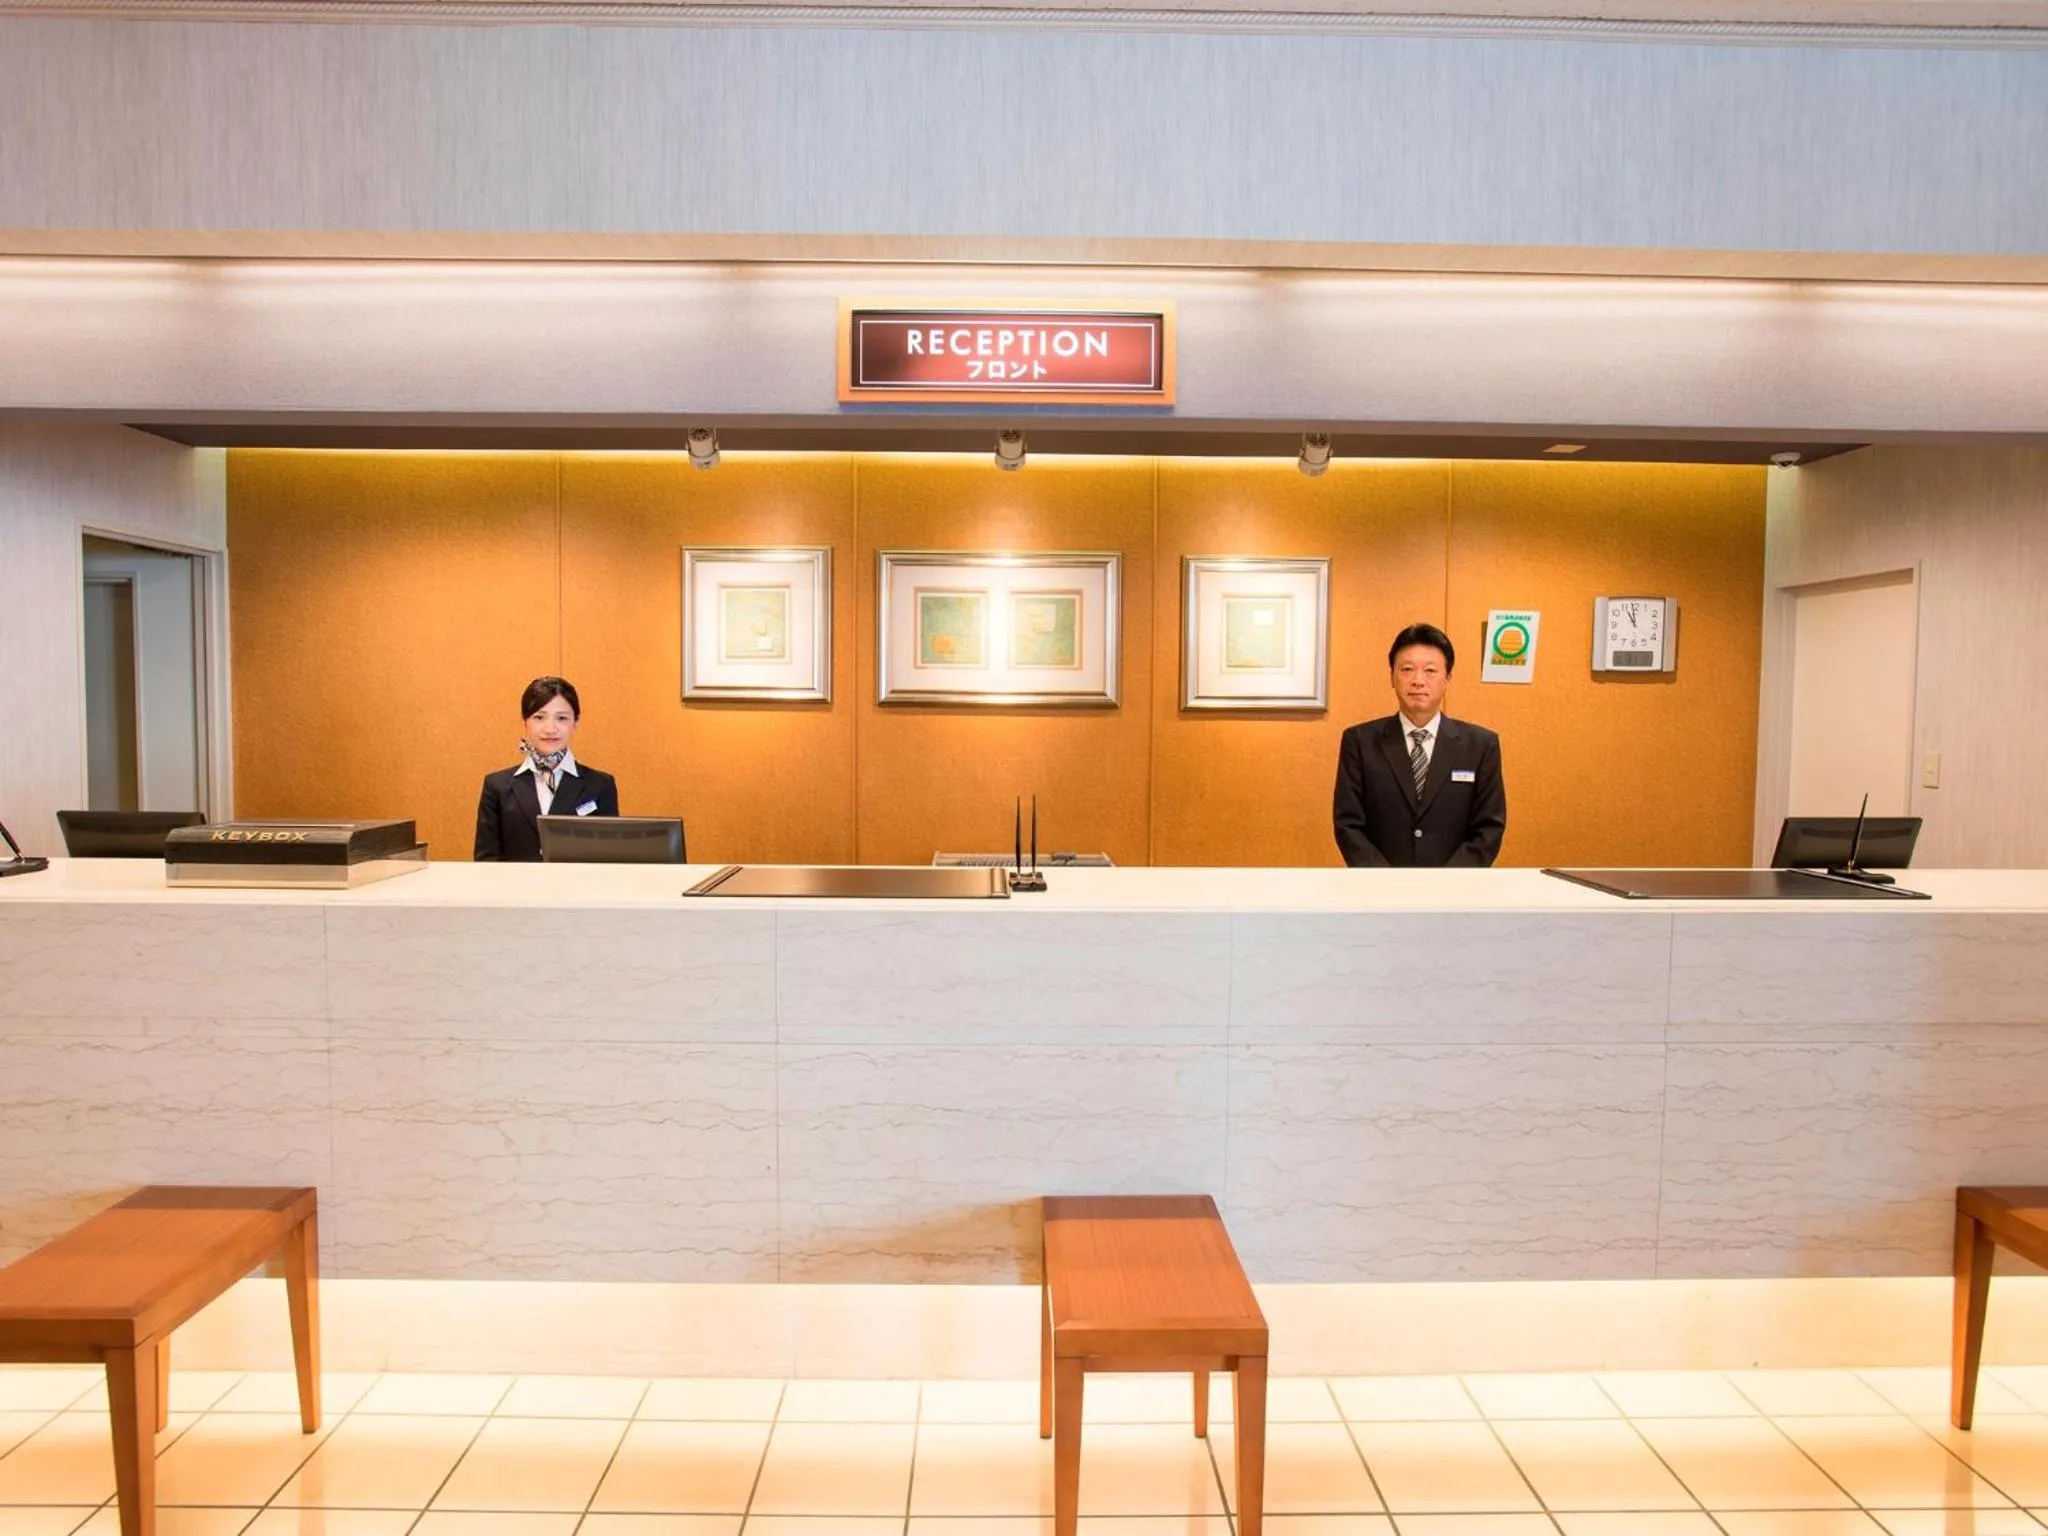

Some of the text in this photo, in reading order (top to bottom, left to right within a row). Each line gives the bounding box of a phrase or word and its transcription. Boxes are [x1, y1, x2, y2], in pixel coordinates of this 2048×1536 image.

[907, 329, 1109, 357] RECEPTION
[966, 360, 1048, 380] フロント
[1621, 603, 1628, 612] 11
[1651, 609, 1658, 618] 2
[1611, 620, 1617, 629] 9
[1651, 620, 1658, 630] 3
[1621, 638, 1627, 647] 7
[1631, 639, 1637, 648] 6
[1641, 638, 1647, 647] 5
[211, 829, 308, 841] KEYBOX
